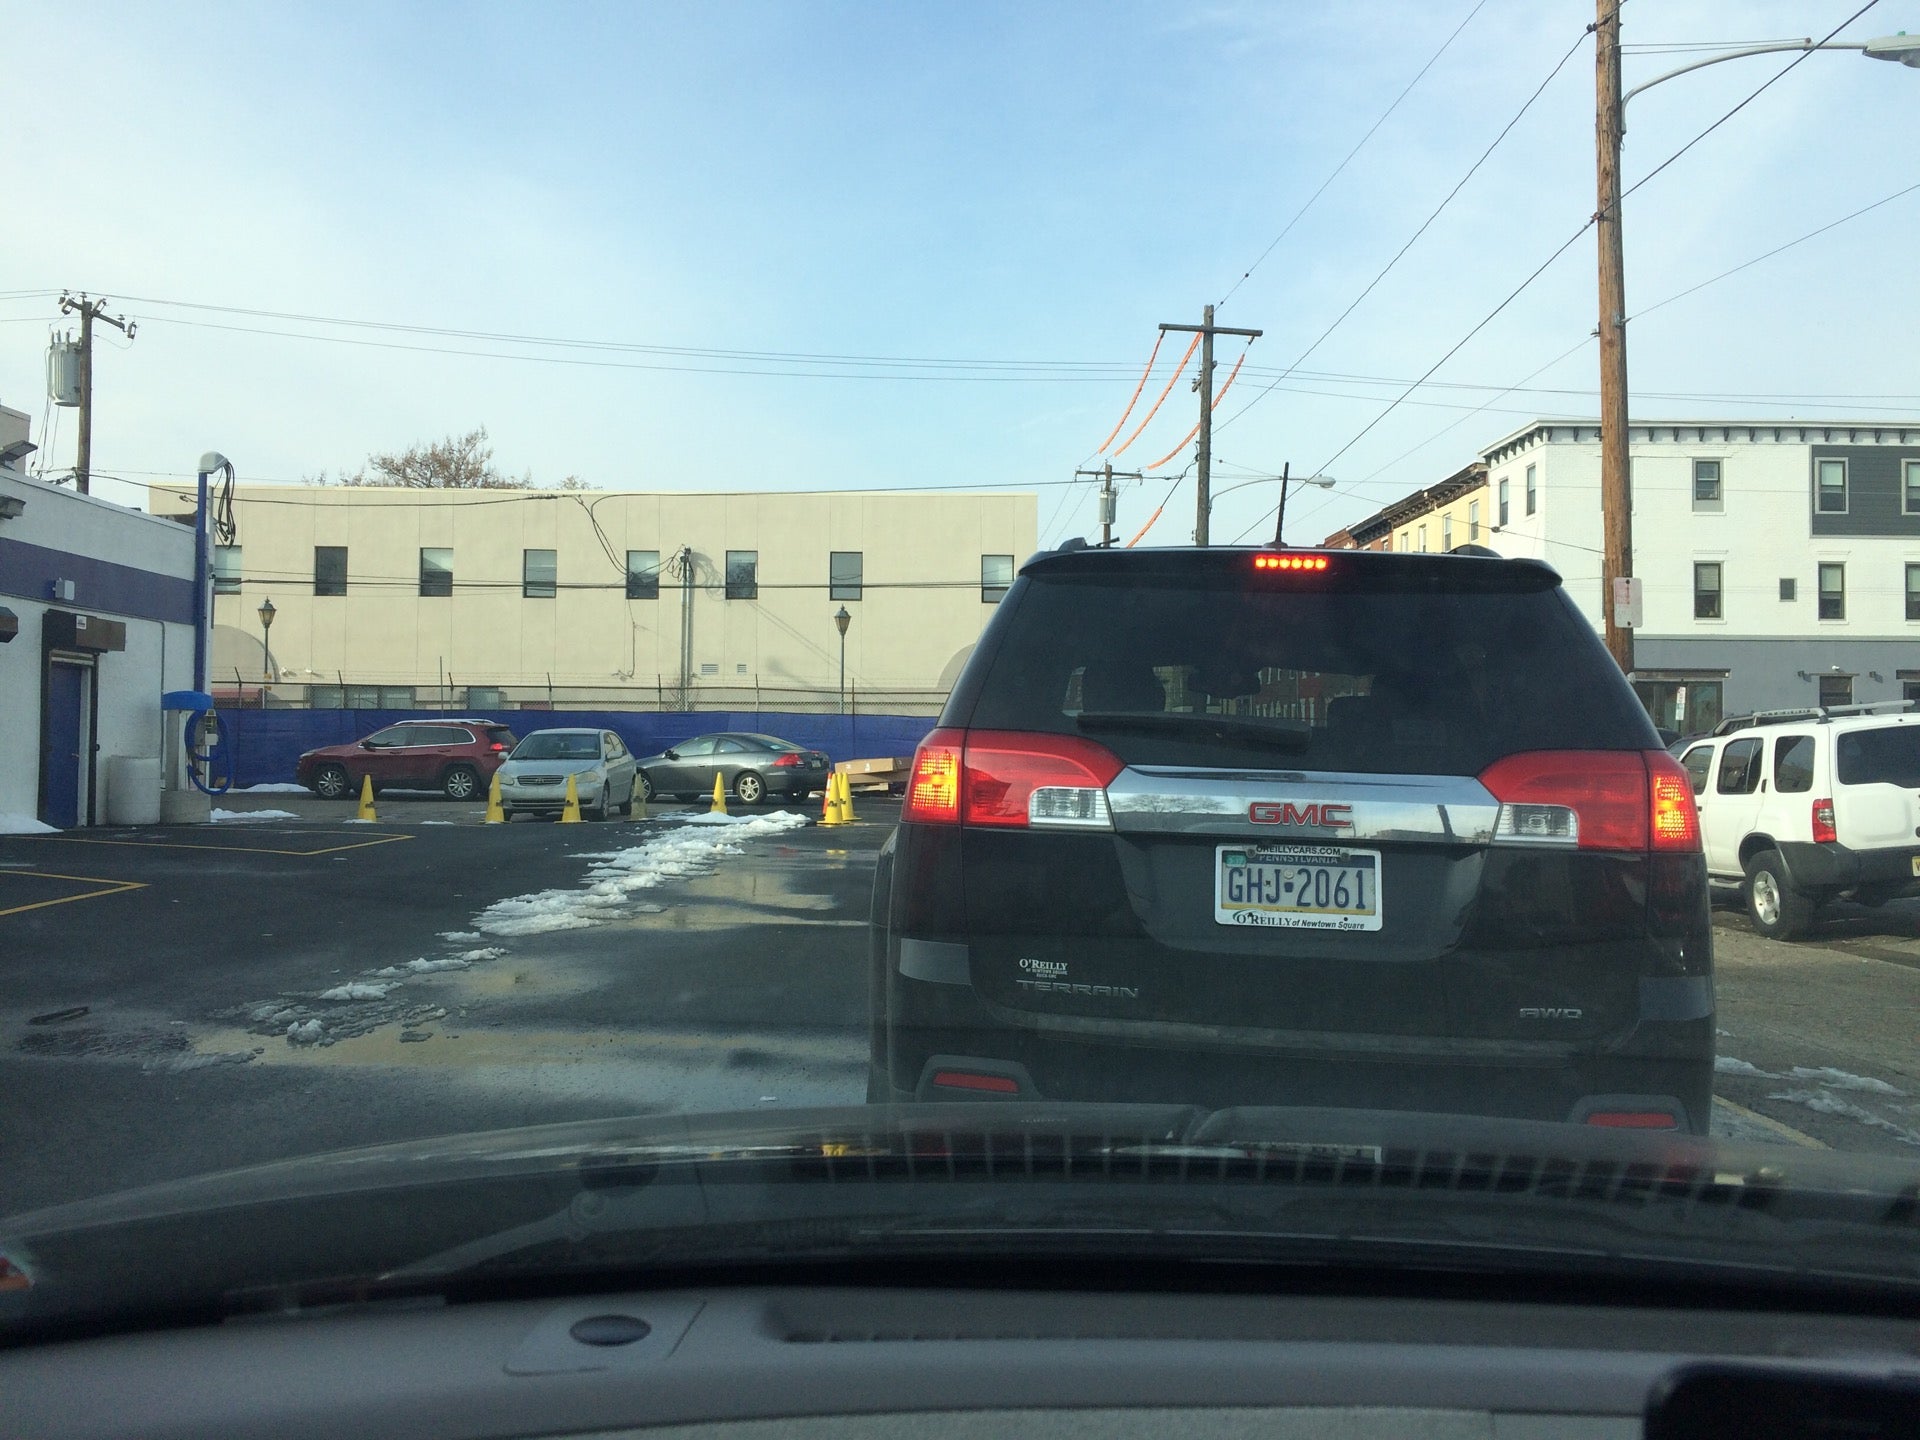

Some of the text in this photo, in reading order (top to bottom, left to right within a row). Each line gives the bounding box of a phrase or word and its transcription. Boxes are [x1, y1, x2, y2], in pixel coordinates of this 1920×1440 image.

[1249, 802, 1353, 828] GMC
[1259, 854, 1338, 864] PENNSYLVANIA
[1291, 919, 1300, 927] of
[1301, 919, 1337, 929] Newtown
[1338, 921, 1365, 930] Square
[1019, 958, 1068, 971] O'REILLY
[1016, 979, 1139, 997] TERRAIN
[1520, 1008, 1582, 1018] AWD
